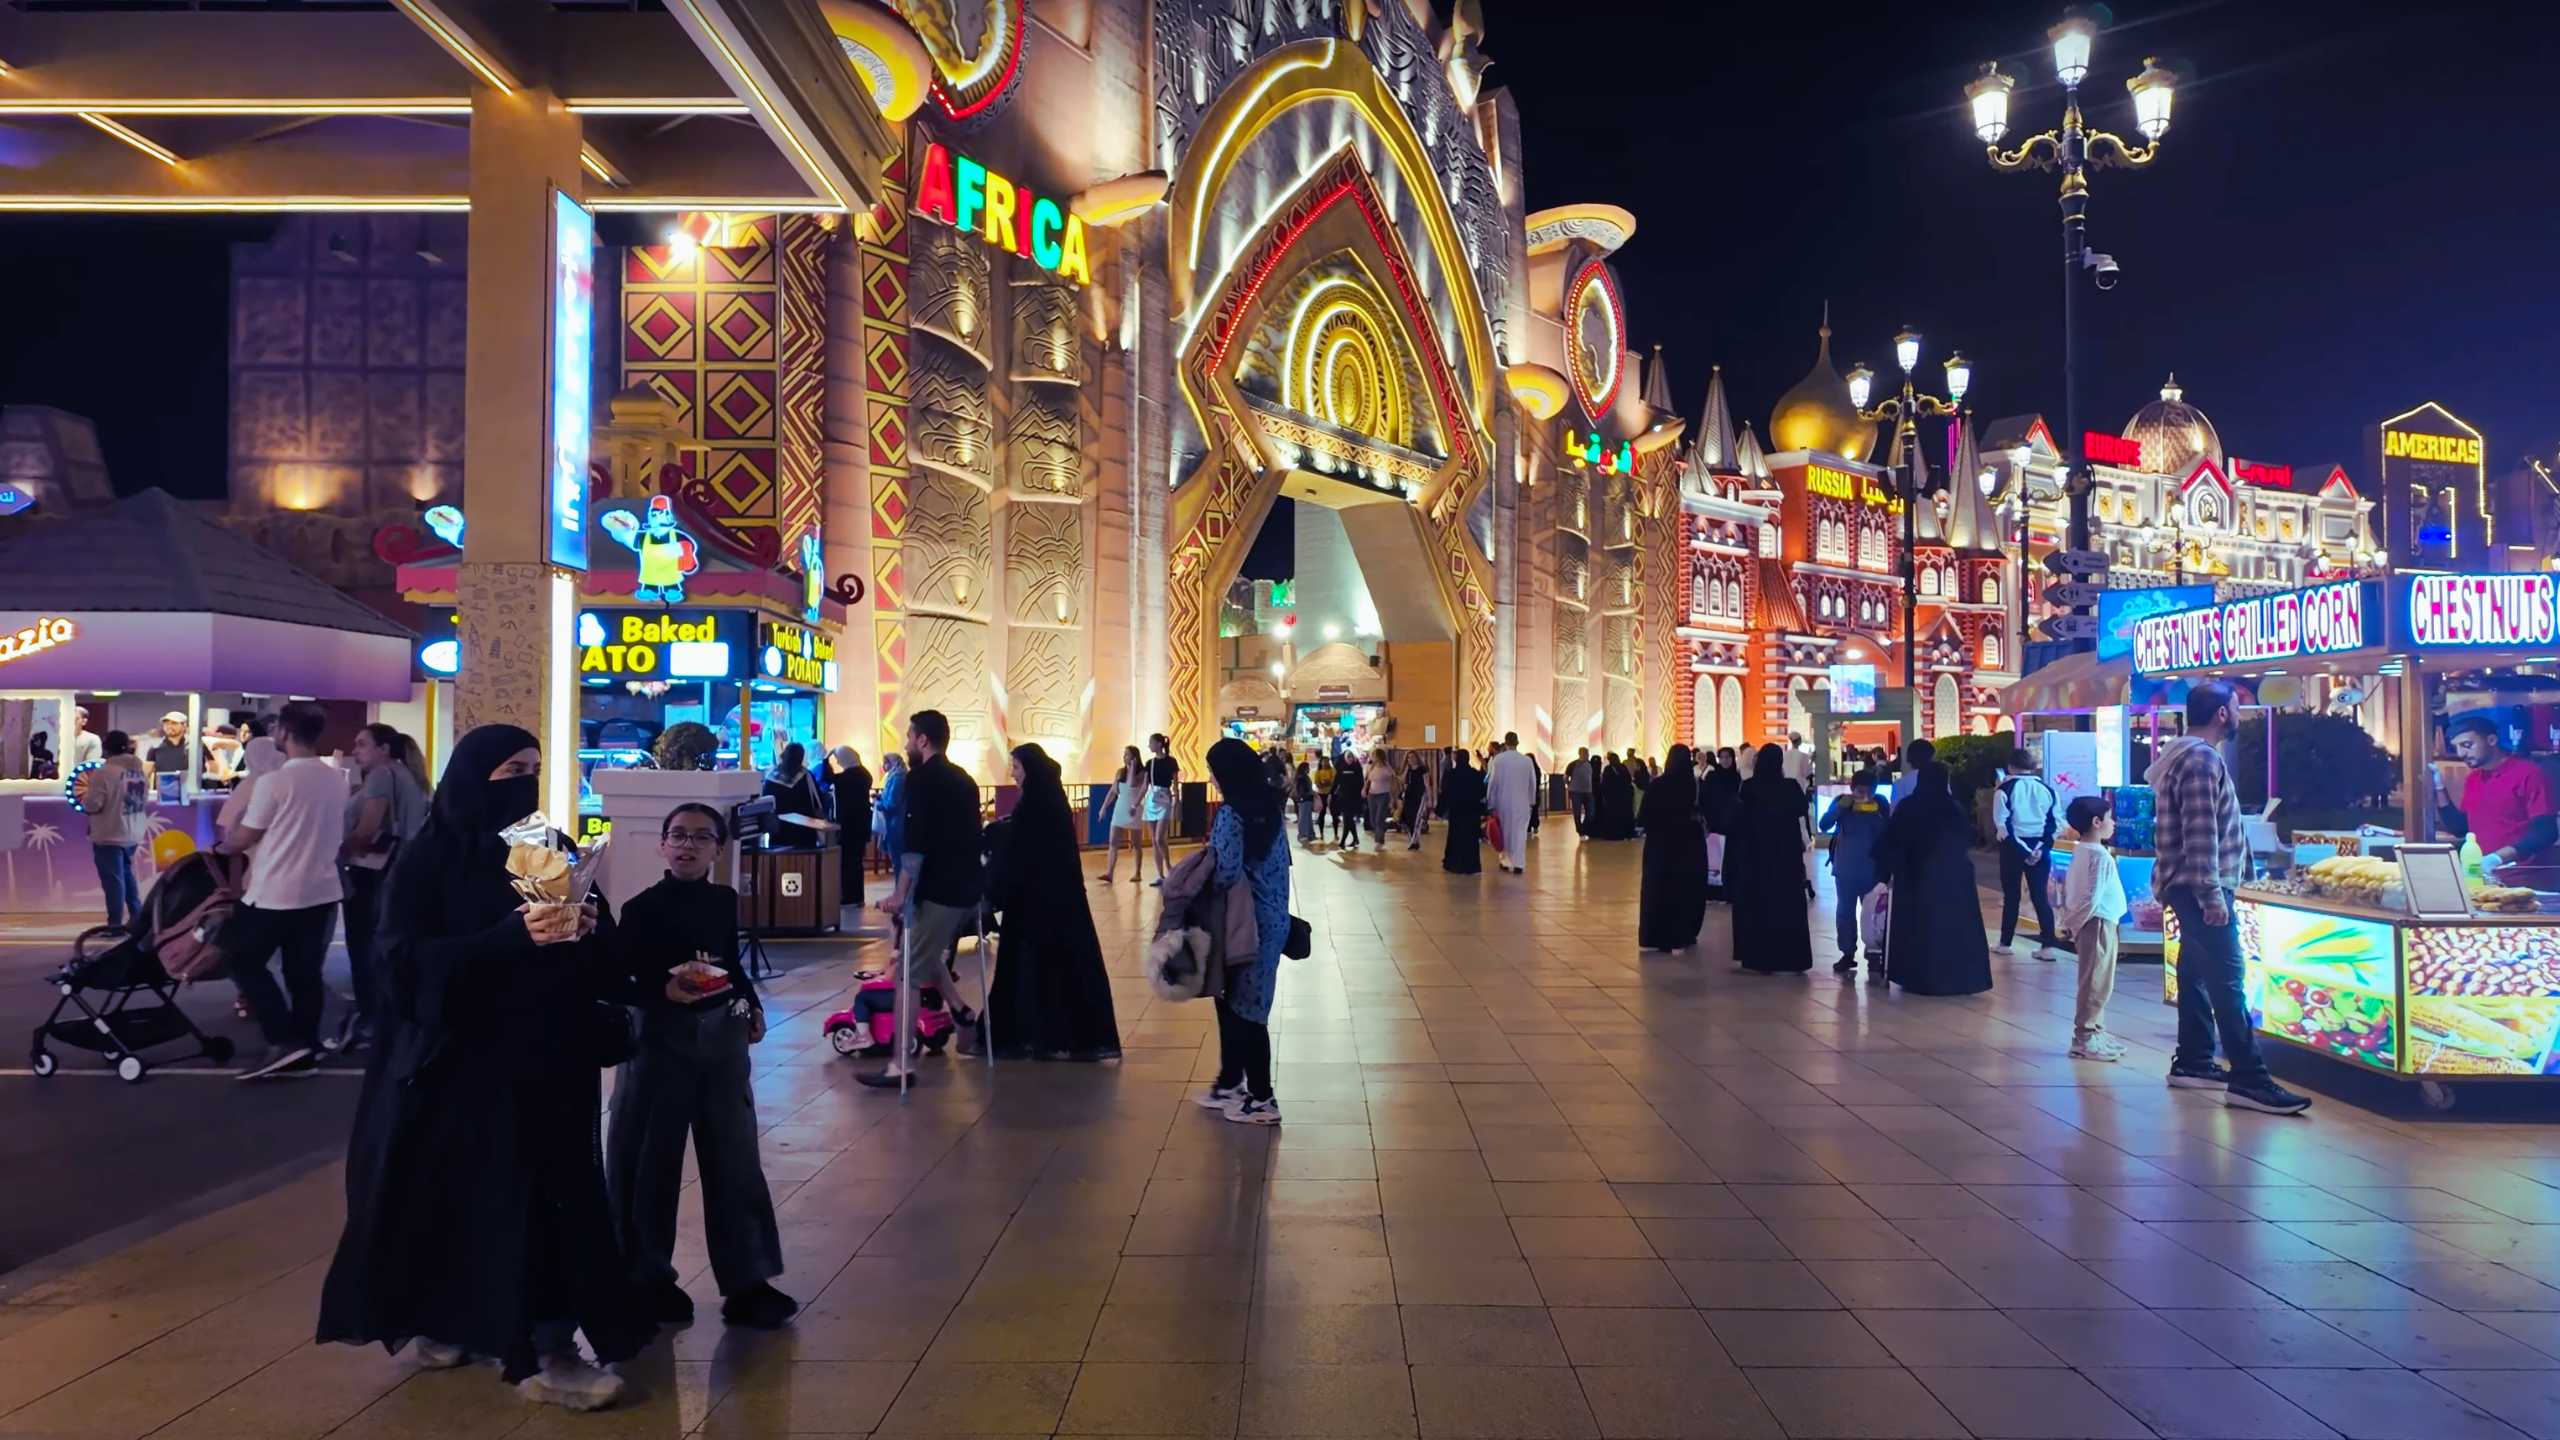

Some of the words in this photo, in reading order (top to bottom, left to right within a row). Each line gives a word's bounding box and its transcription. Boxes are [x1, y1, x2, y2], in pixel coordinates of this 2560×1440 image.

[915, 143, 1090, 285] AFRICA
[2084, 431, 2141, 467] EUROPE
[2385, 431, 2480, 464] AMERICAS
[1807, 465, 1853, 500] RUSSIA
[2133, 606, 2222, 673] CHESTNUTS
[2223, 594, 2300, 663] GRILLED
[2302, 580, 2363, 654] CORN
[2411, 574, 2555, 644] CHESTNUTS
[622, 614, 715, 643] Baked
[787, 653, 822, 685] POTATO
